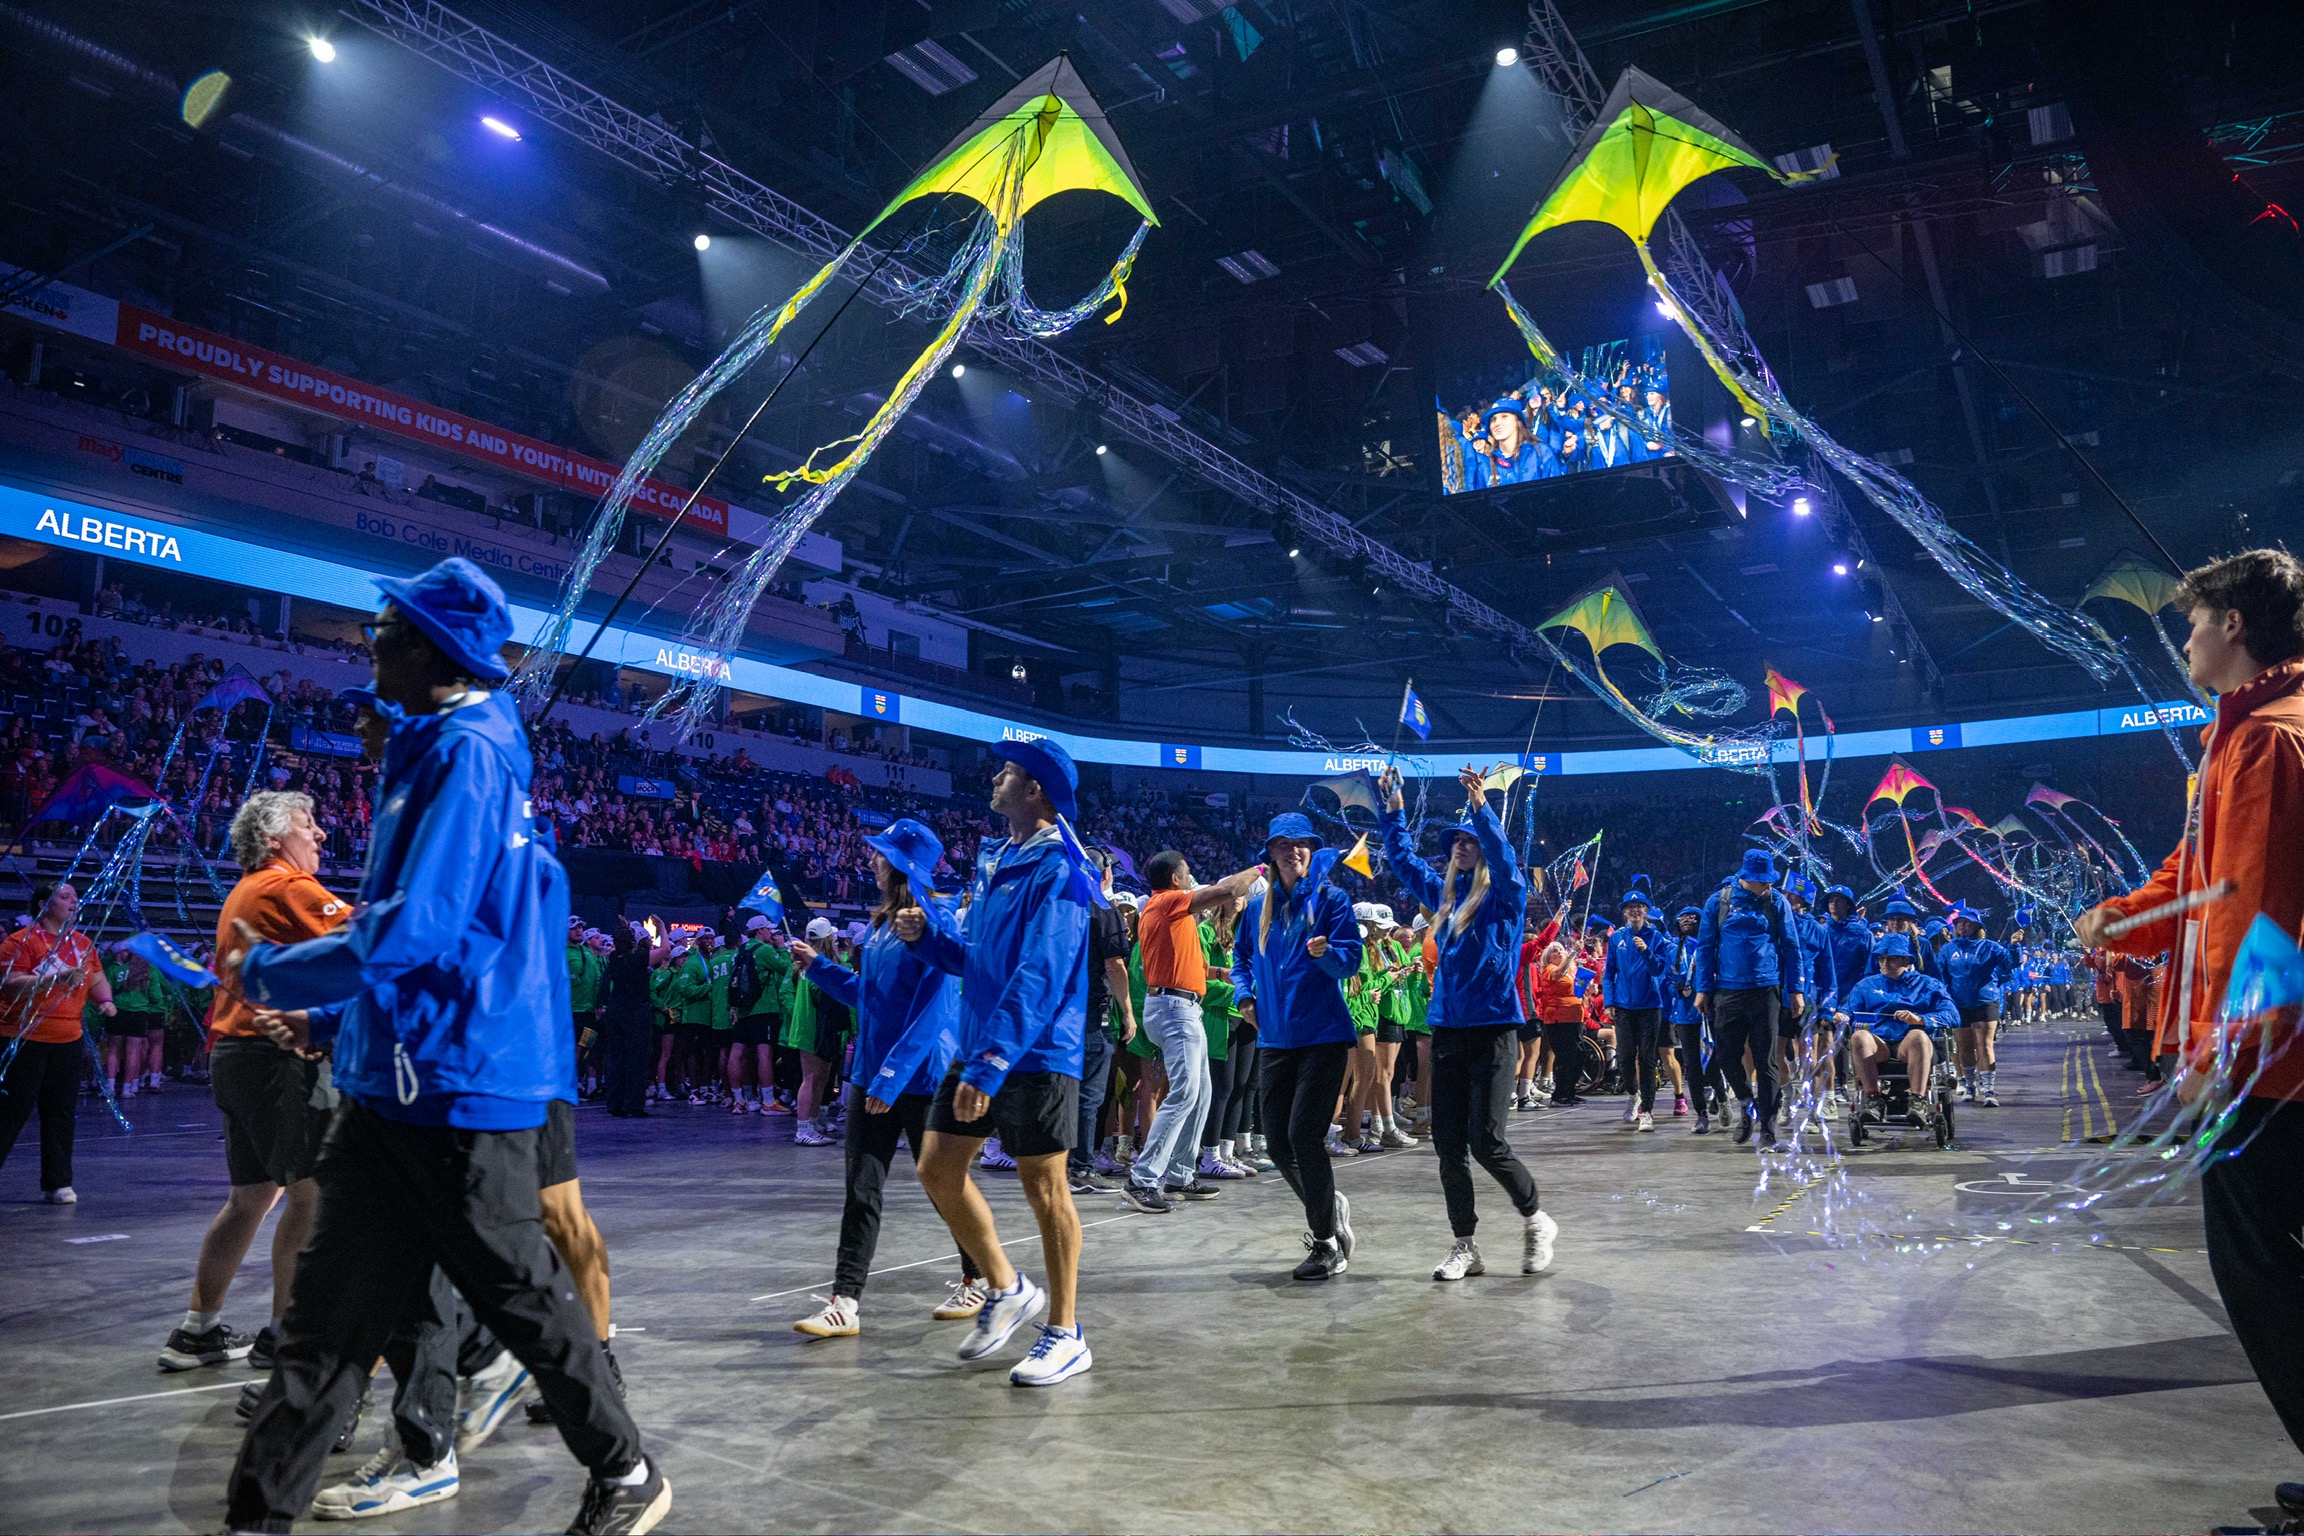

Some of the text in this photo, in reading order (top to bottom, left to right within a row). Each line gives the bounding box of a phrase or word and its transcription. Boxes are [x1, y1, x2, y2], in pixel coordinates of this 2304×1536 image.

[139, 322, 265, 378] PROUDLY
[268, 365, 412, 426] SUPPORTING
[416, 411, 463, 441] KIDS
[466, 430, 508, 455] AND
[511, 442, 573, 476] YOUTH
[626, 478, 657, 504] GC
[131, 464, 183, 484] CENTRE
[35, 508, 182, 562] ALBERTA
[356, 512, 576, 584] Bob Cole Media Centre
[26, 611, 82, 639] 108
[2121, 705, 2206, 728] ALBERTA
[689, 732, 714, 750] 110
[1002, 726, 1048, 744] ALBER
[1698, 746, 1768, 763] LBERTA
[884, 764, 905, 780] 111
[1324, 758, 1387, 772] ALBERTA
